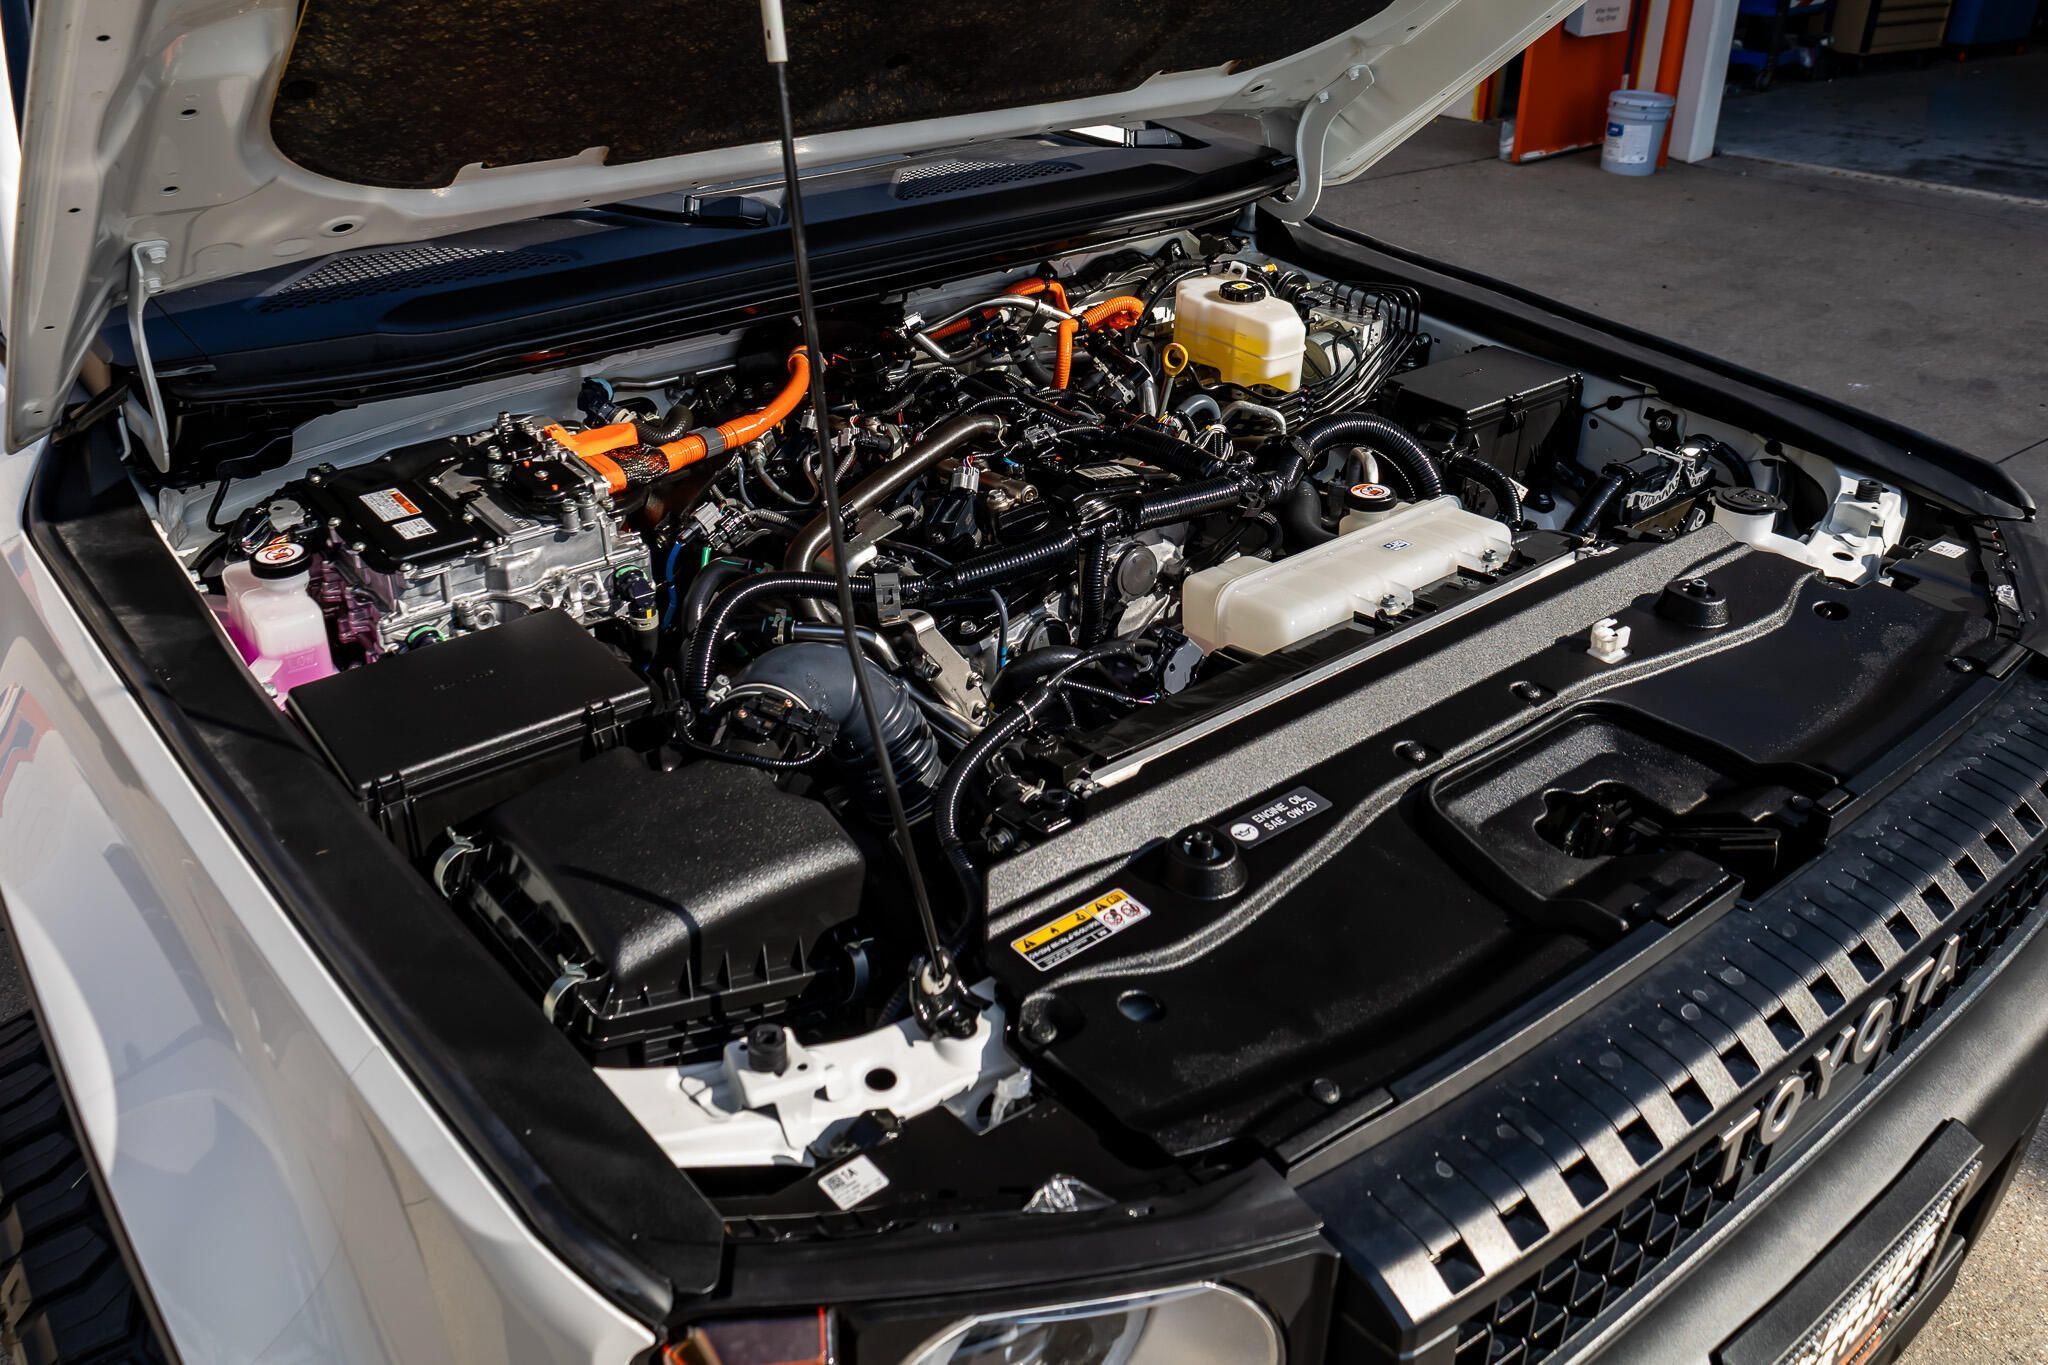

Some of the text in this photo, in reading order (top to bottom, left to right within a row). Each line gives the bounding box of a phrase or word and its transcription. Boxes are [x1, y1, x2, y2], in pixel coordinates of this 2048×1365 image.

[1251, 795, 1307, 823] ENGINE OIL
[1263, 801, 1317, 830] SAE 0W-20
[1719, 933, 1960, 1187] TOYOTA
